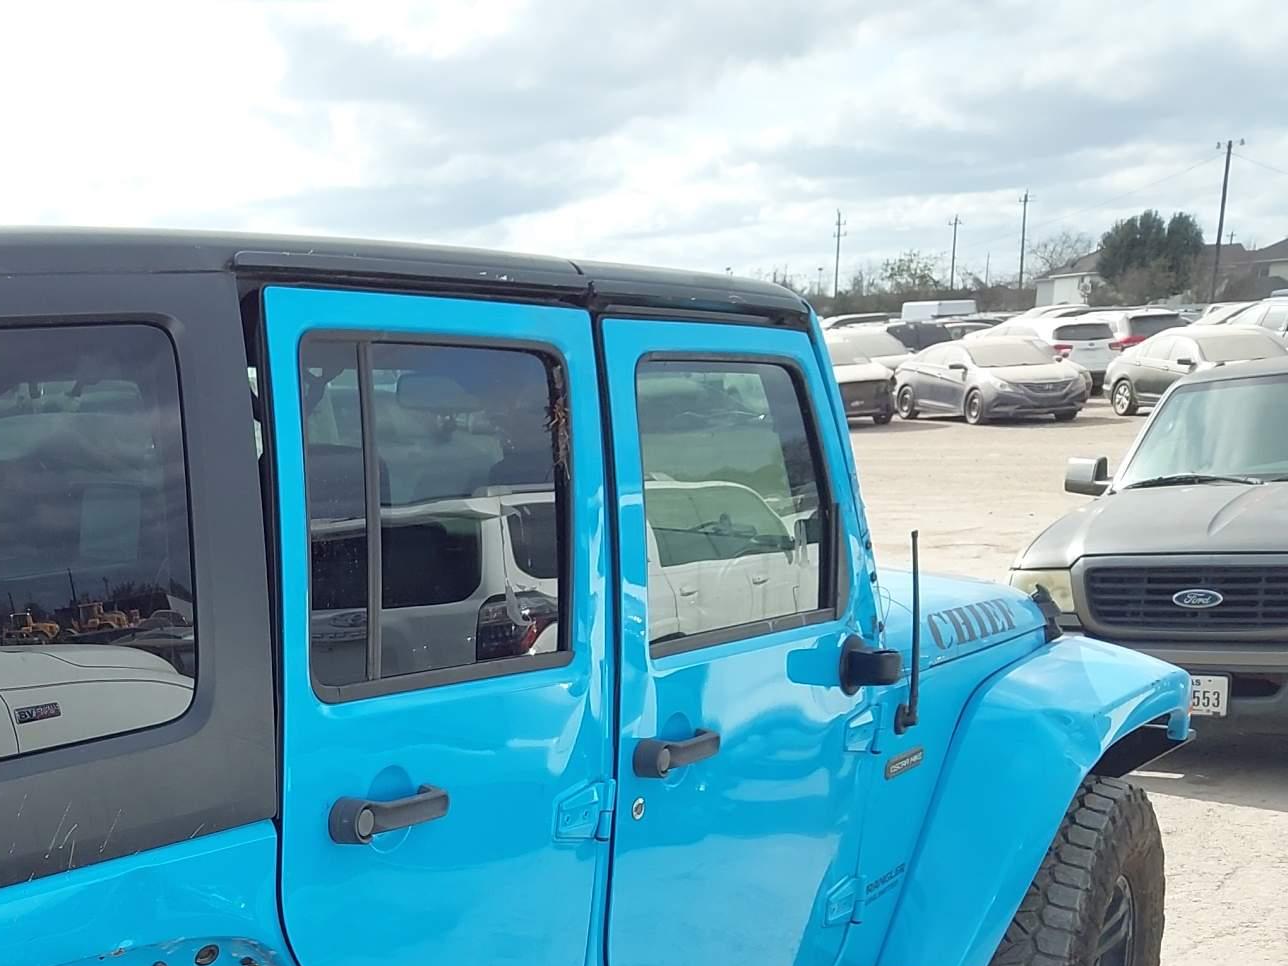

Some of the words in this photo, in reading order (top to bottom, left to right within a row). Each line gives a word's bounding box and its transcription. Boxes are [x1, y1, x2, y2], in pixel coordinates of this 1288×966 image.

[1184, 593, 1211, 604] Ford
[927, 599, 1015, 649] CHIEF
[1192, 690, 1220, 708] 553
